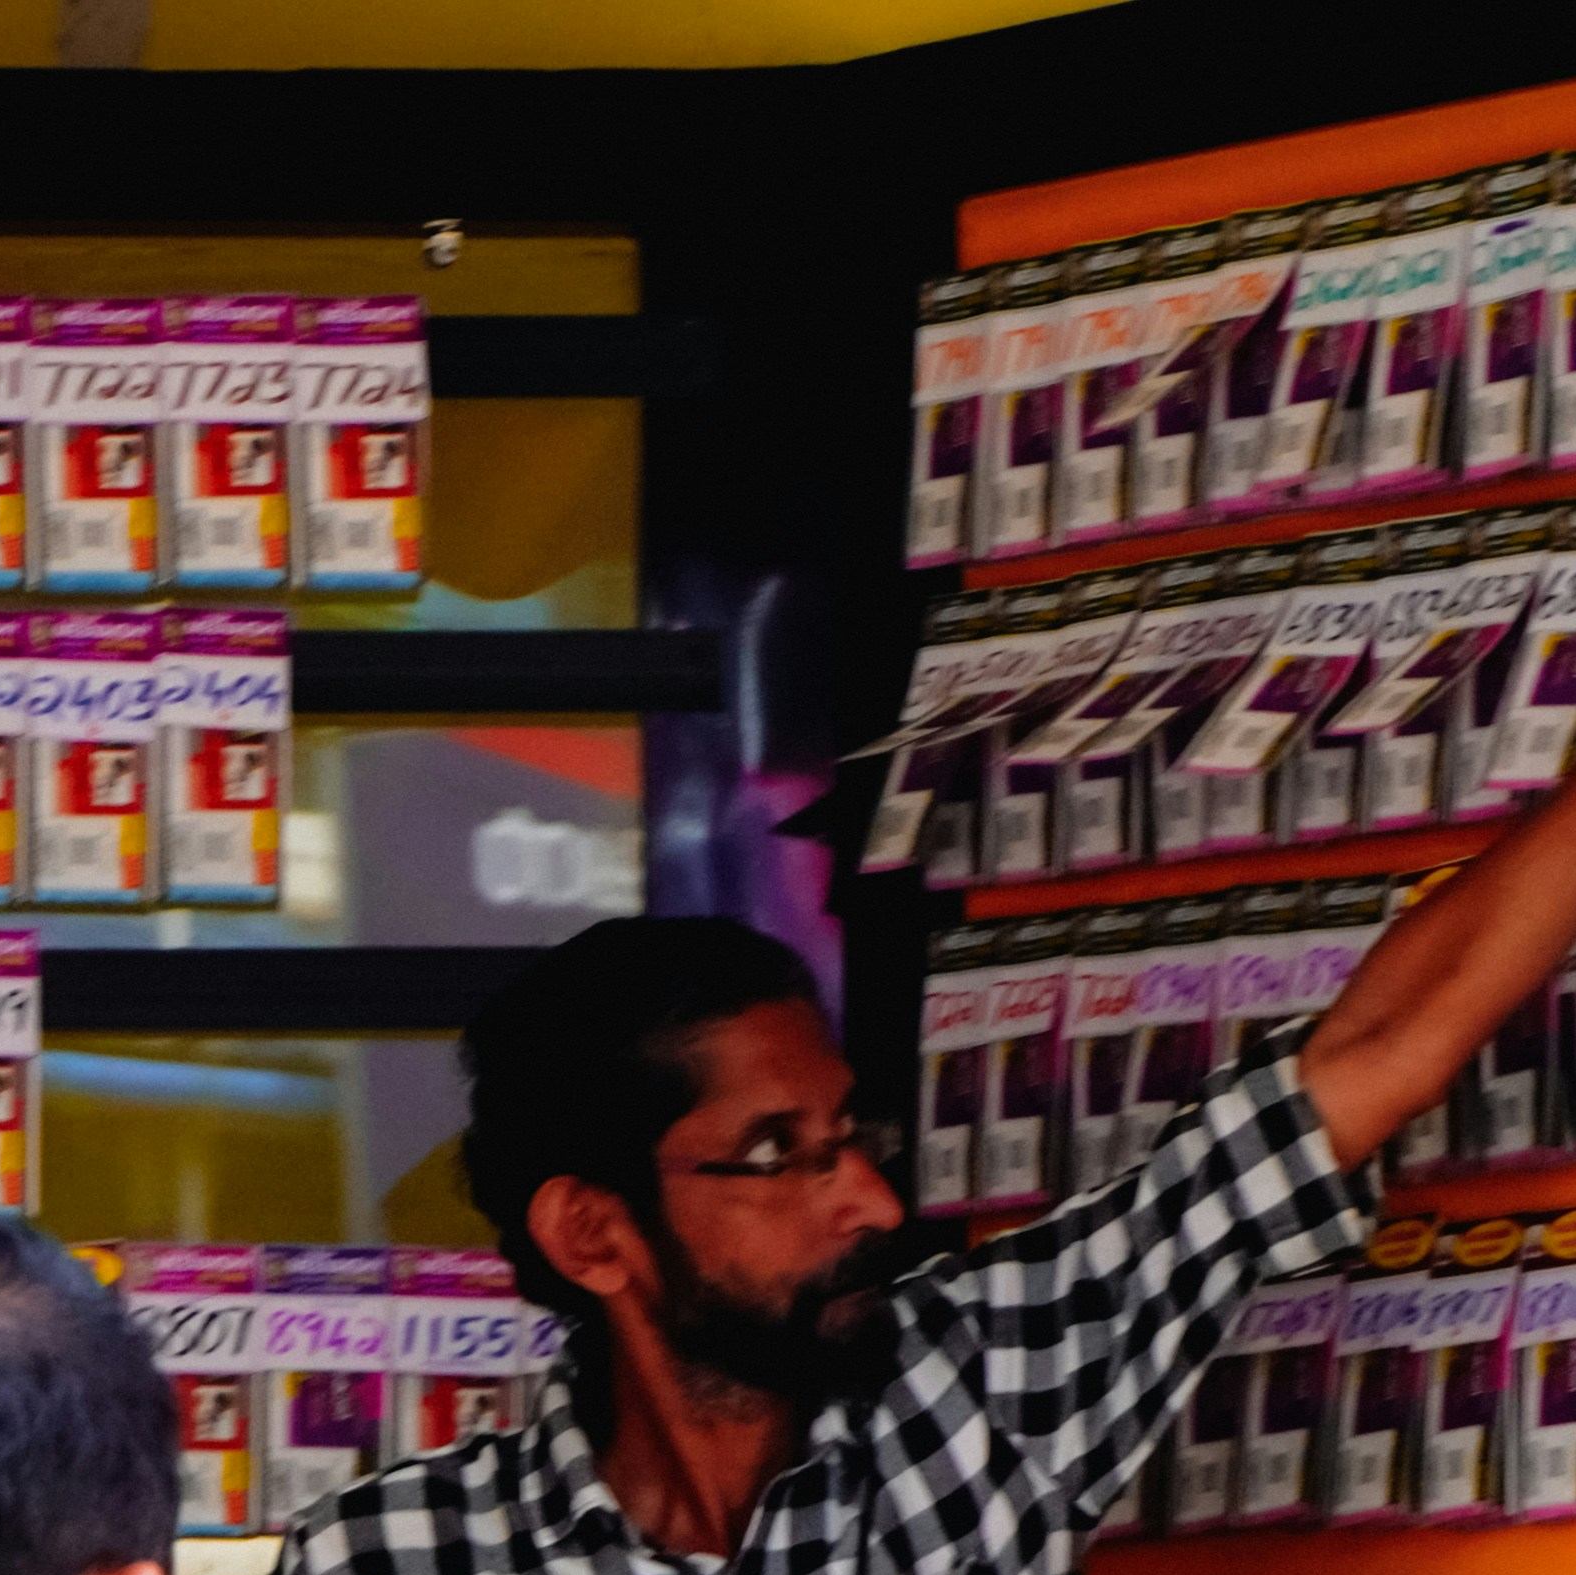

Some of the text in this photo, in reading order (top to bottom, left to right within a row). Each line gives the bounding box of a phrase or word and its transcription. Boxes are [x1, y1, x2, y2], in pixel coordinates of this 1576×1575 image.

[33, 361, 161, 408] 7722
[163, 360, 291, 411] 7723
[297, 363, 425, 412] 7724
[27, 674, 156, 722] 2403
[156, 665, 283, 712] 2404
[400, 1314, 517, 1359] 1155
